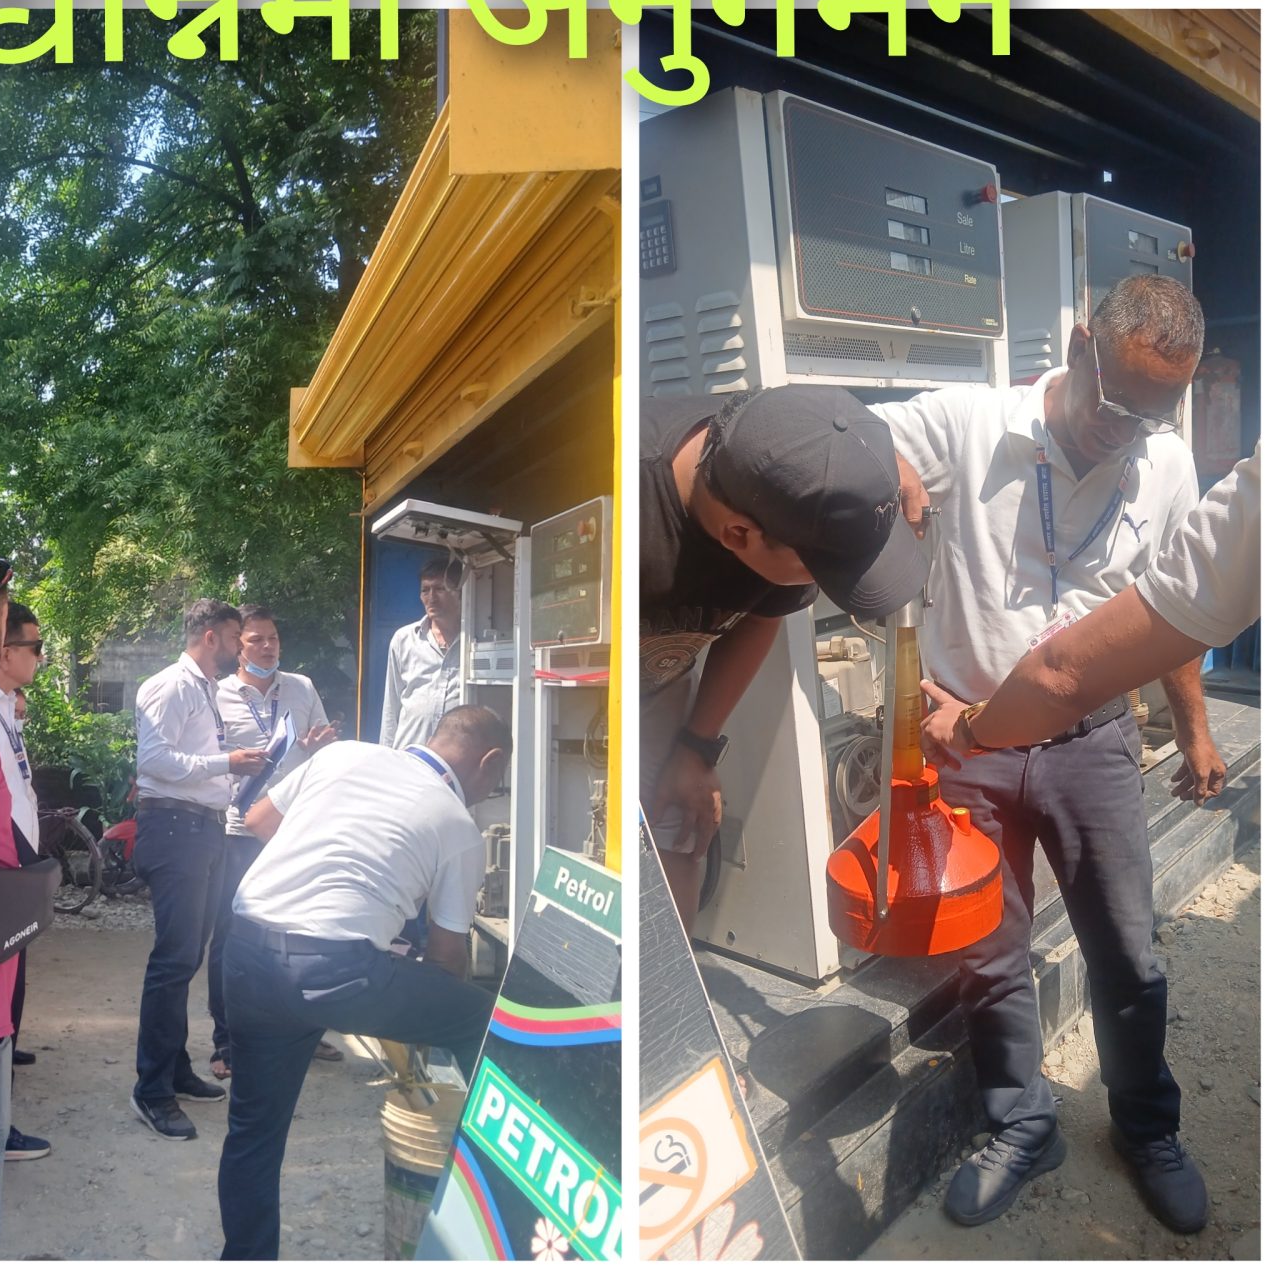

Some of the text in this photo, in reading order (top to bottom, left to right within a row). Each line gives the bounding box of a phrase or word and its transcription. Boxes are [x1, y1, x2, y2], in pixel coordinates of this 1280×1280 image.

[956, 211, 974, 227] Sale
[959, 241, 975, 256] Litre
[964, 273, 977, 285] Rate
[553, 865, 615, 917] Petrol
[3, 920, 39, 951] AGONEIR
[475, 1081, 622, 1261] PETROL
